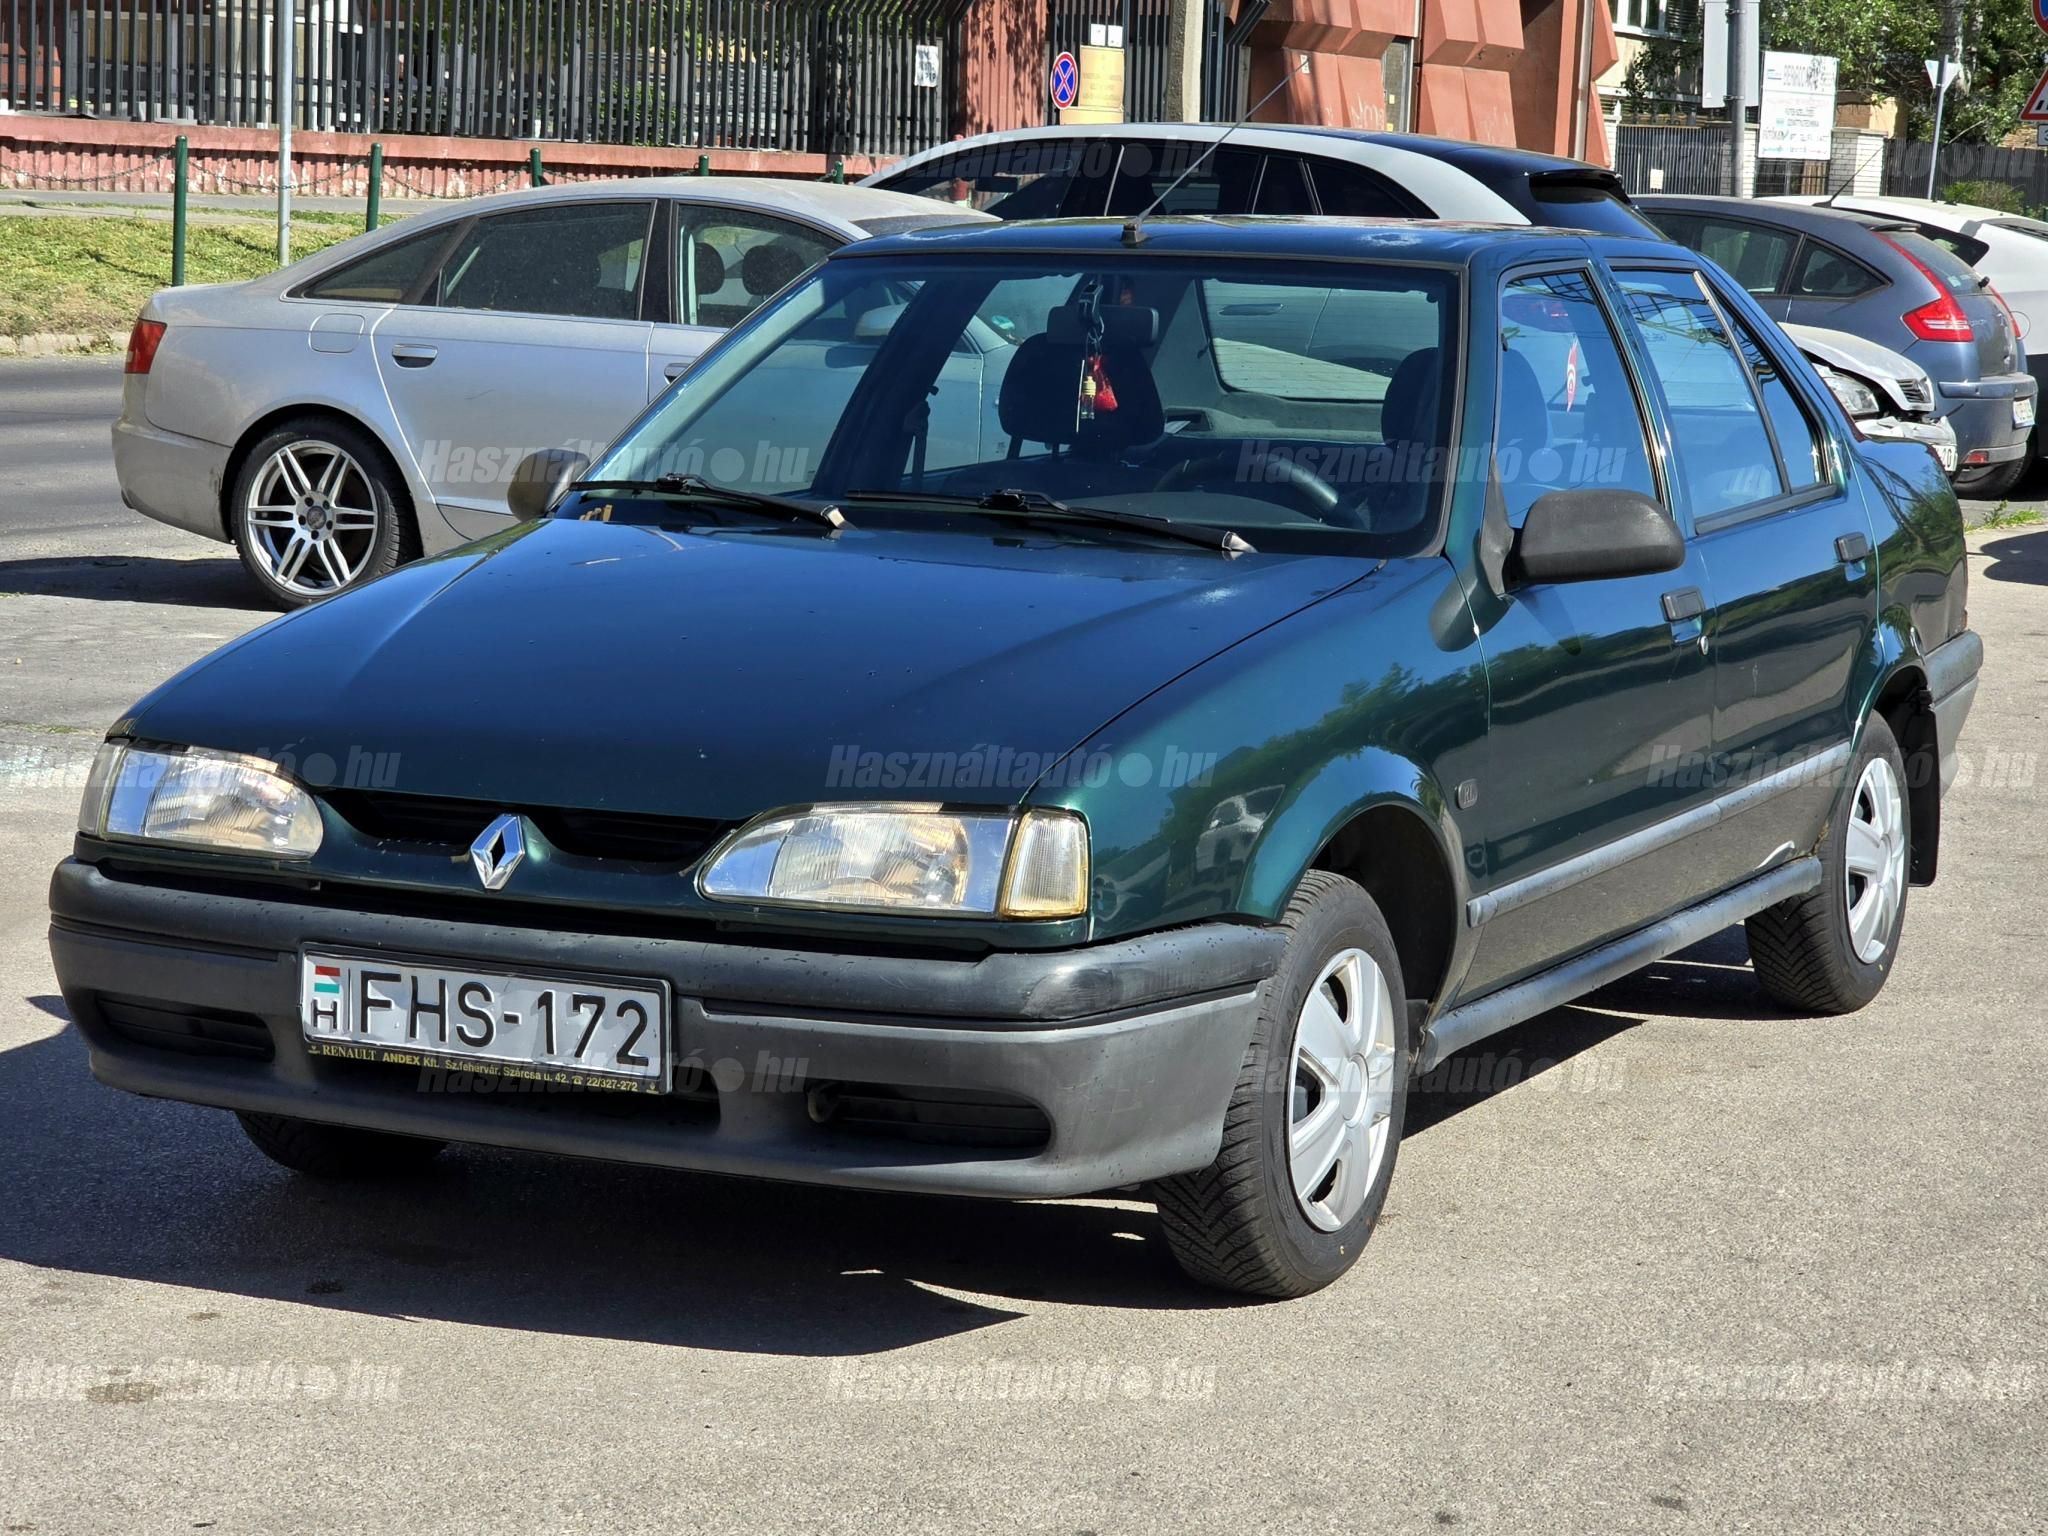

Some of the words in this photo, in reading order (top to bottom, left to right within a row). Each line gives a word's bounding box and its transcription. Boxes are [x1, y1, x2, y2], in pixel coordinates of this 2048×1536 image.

[312, 997, 338, 1031] H
[361, 970, 649, 1067] FHS-172
[322, 1045, 377, 1061] RENAULT
[382, 1052, 421, 1066] ANDEX
[503, 1066, 542, 1081] Szárcsa
[586, 1077, 638, 1092] 22/327-272
